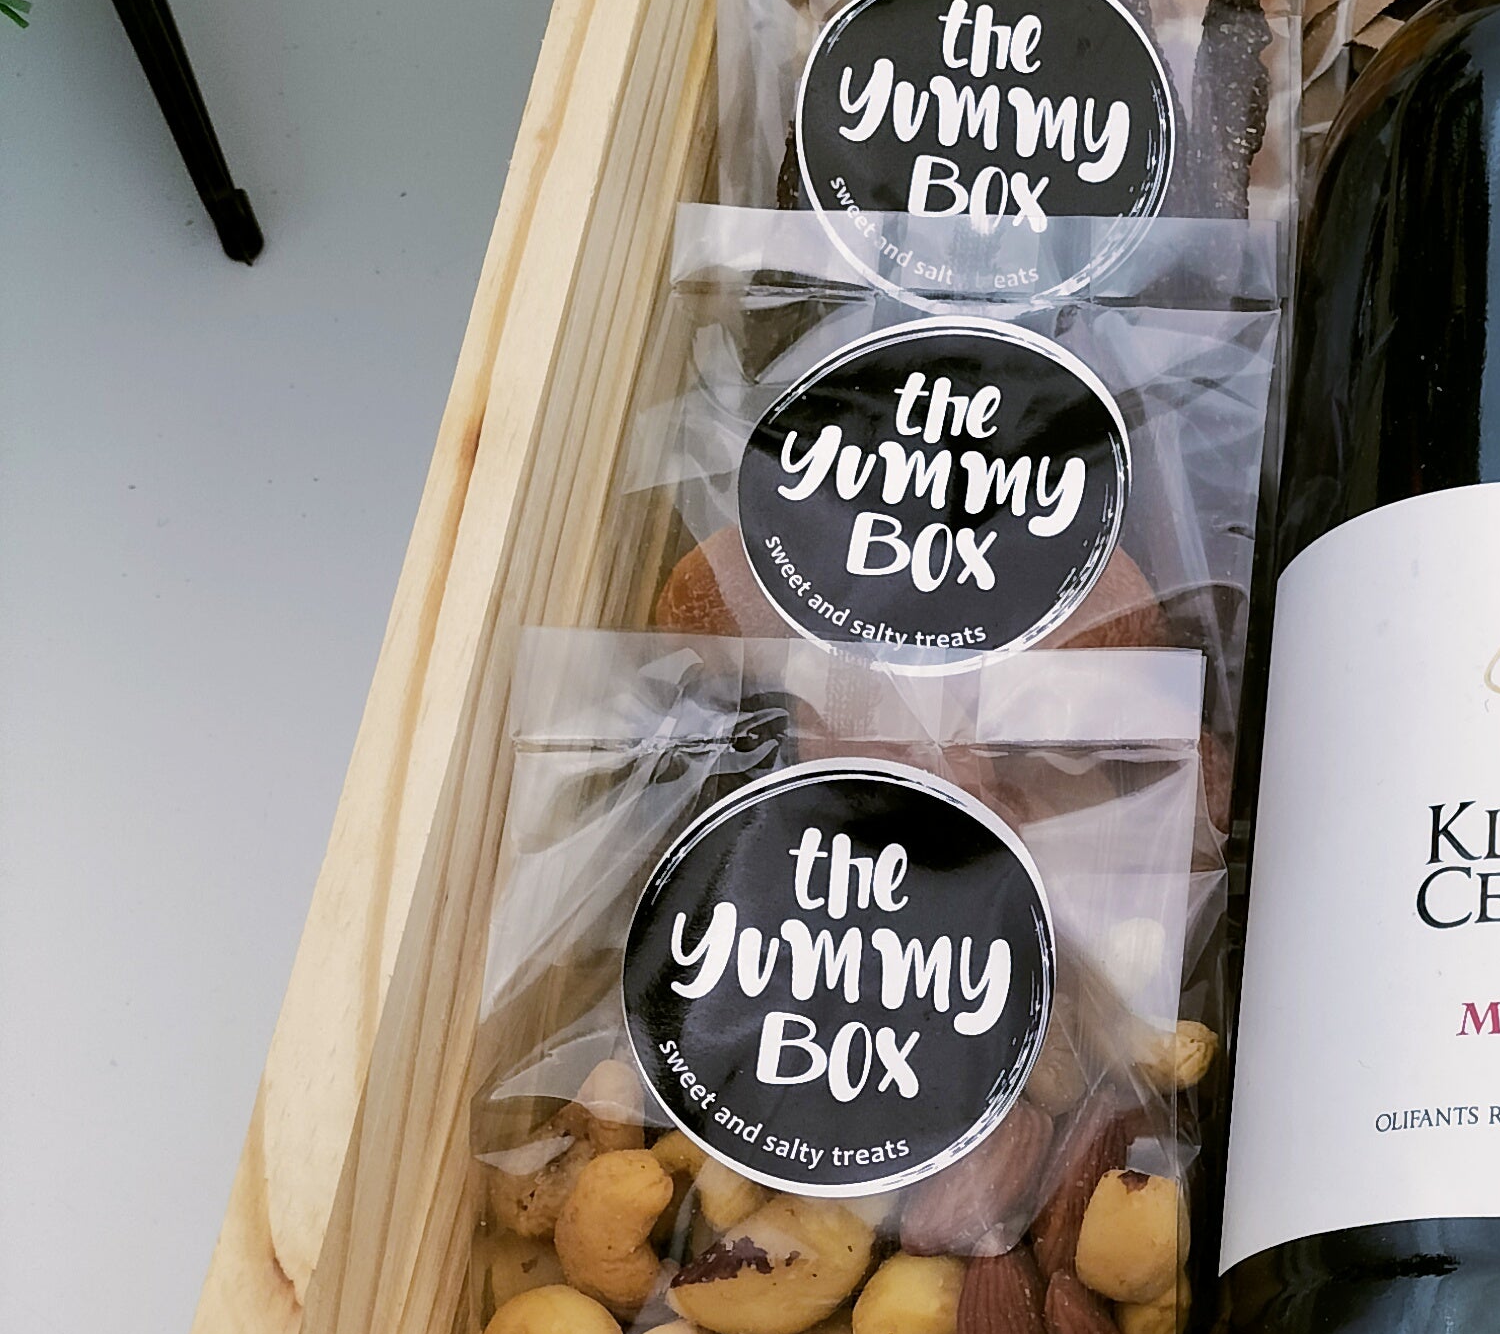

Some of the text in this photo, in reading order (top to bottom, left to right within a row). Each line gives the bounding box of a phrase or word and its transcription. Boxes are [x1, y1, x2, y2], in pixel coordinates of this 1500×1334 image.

[838, 58, 1130, 183] yummy
[830, 176, 1040, 289] sweet and salt eats
[893, 371, 1002, 444] the
[777, 424, 1086, 538] yummy
[765, 534, 988, 652] sweet and salty treats
[788, 826, 909, 920] the
[670, 901, 1012, 1037] yummy
[659, 1039, 911, 1170] sweet and salty treats
[1375, 1106, 1480, 1134] OLIFANTS
